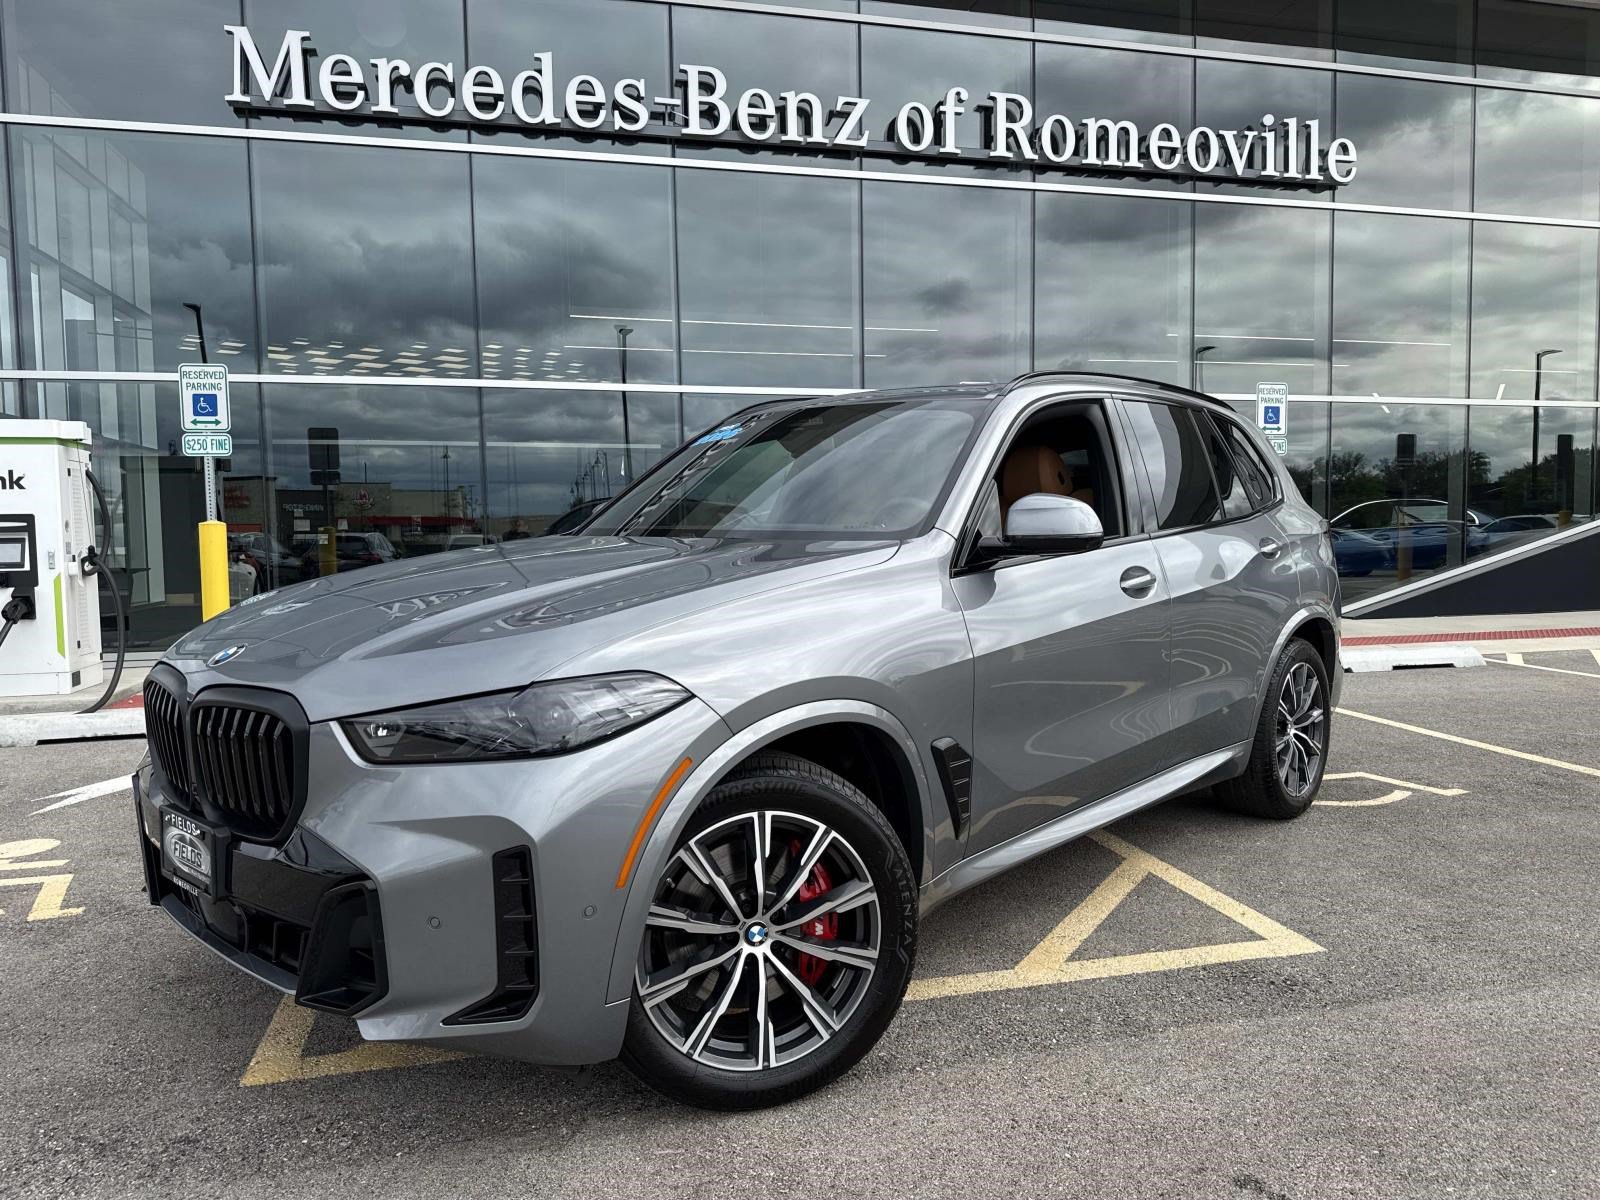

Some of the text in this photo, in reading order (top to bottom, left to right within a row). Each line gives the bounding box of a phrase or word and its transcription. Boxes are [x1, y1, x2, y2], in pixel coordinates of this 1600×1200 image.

[223, 24, 1358, 184] Mercedes-Benz of Romeoville
[182, 370, 225, 380] RESERVED
[186, 381, 222, 391] PARKING
[1259, 387, 1285, 396] RESERVED
[1260, 396, 1284, 404] PARKING
[186, 438, 229, 451] $250 FINE
[171, 813, 197, 836] FIELDS
[173, 840, 203, 869] FIELDS
[892, 867, 913, 946] ALENZA
